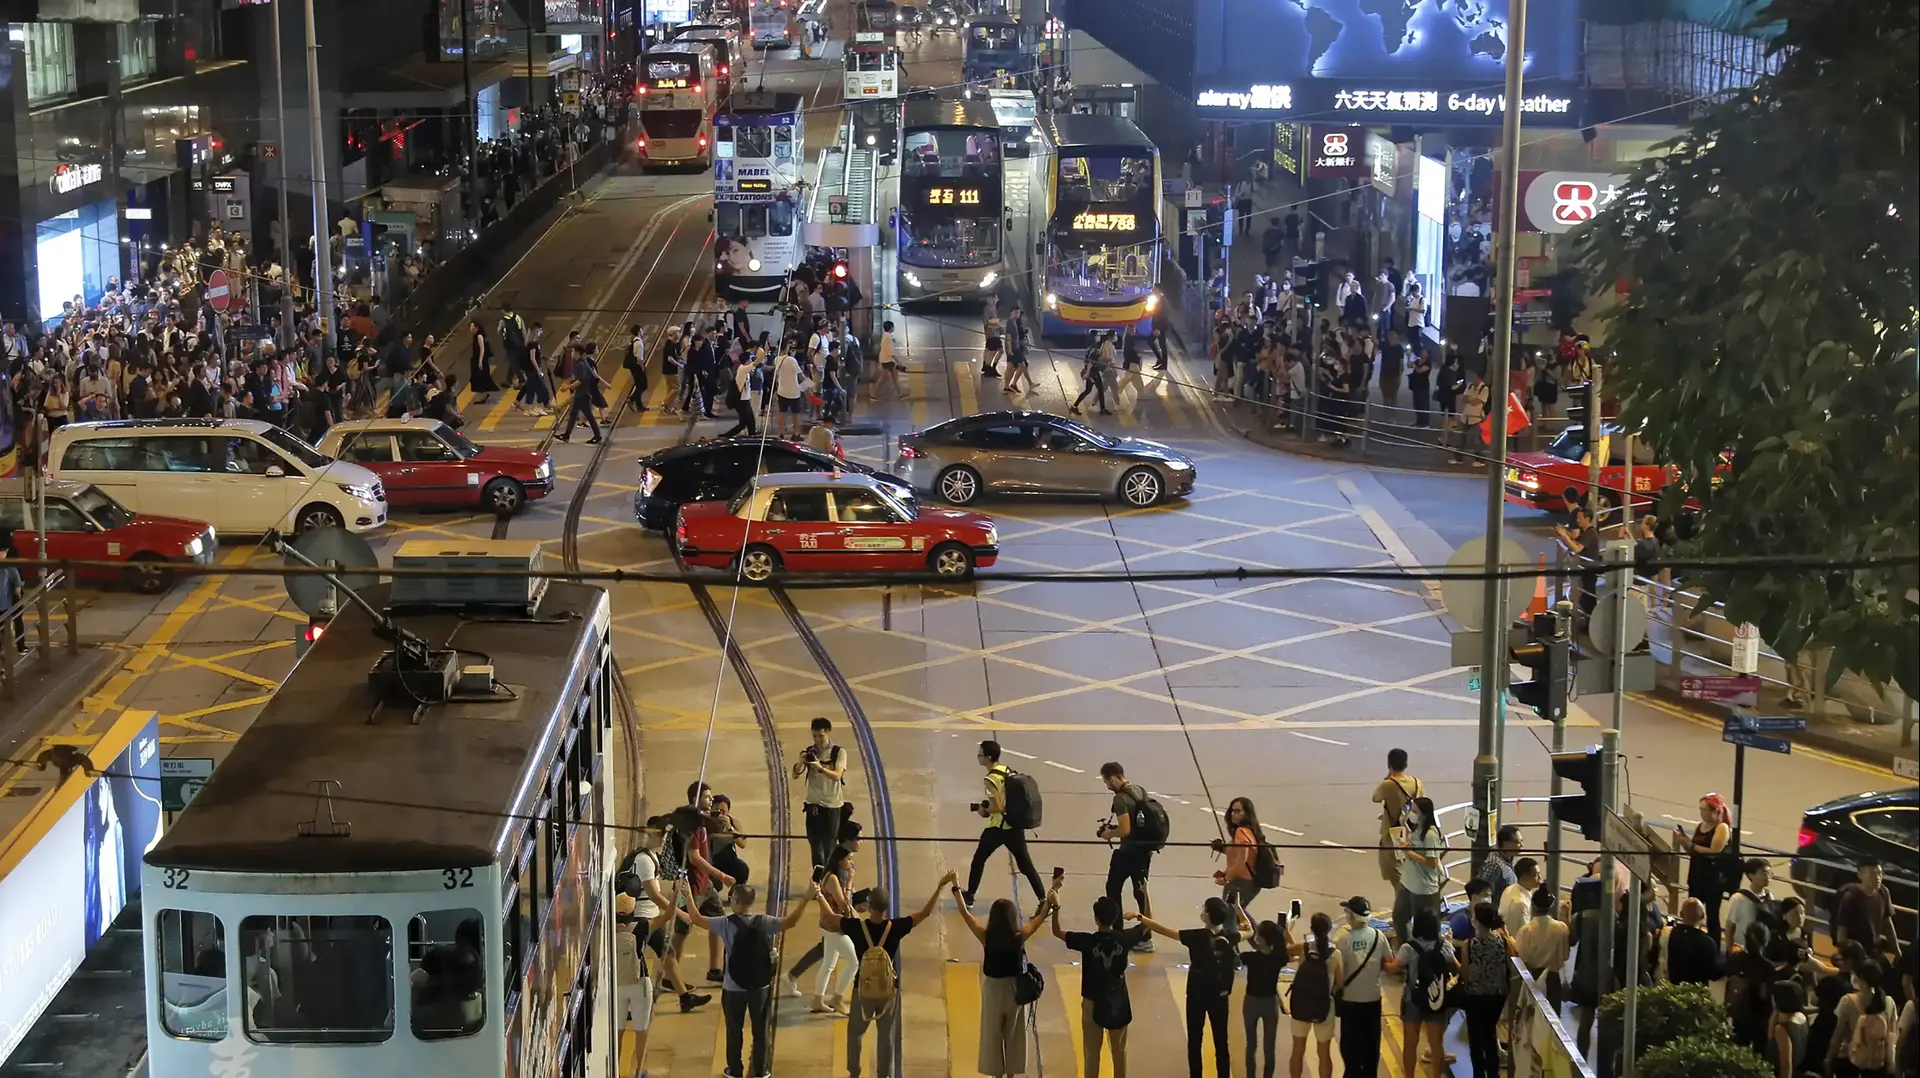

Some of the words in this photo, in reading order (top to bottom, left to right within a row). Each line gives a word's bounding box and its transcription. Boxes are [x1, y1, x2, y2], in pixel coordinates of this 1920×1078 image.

[1448, 93, 1496, 115] 6-day
[1315, 157, 1355, 167] 大新銀行
[738, 168, 771, 176] MABEL
[715, 193, 773, 201] EXPECTATIONS
[959, 189, 980, 203] 111
[799, 533, 818, 541] 的士
[799, 540, 818, 549] TAXI
[163, 867, 190, 889] 32
[442, 867, 474, 890] 32
